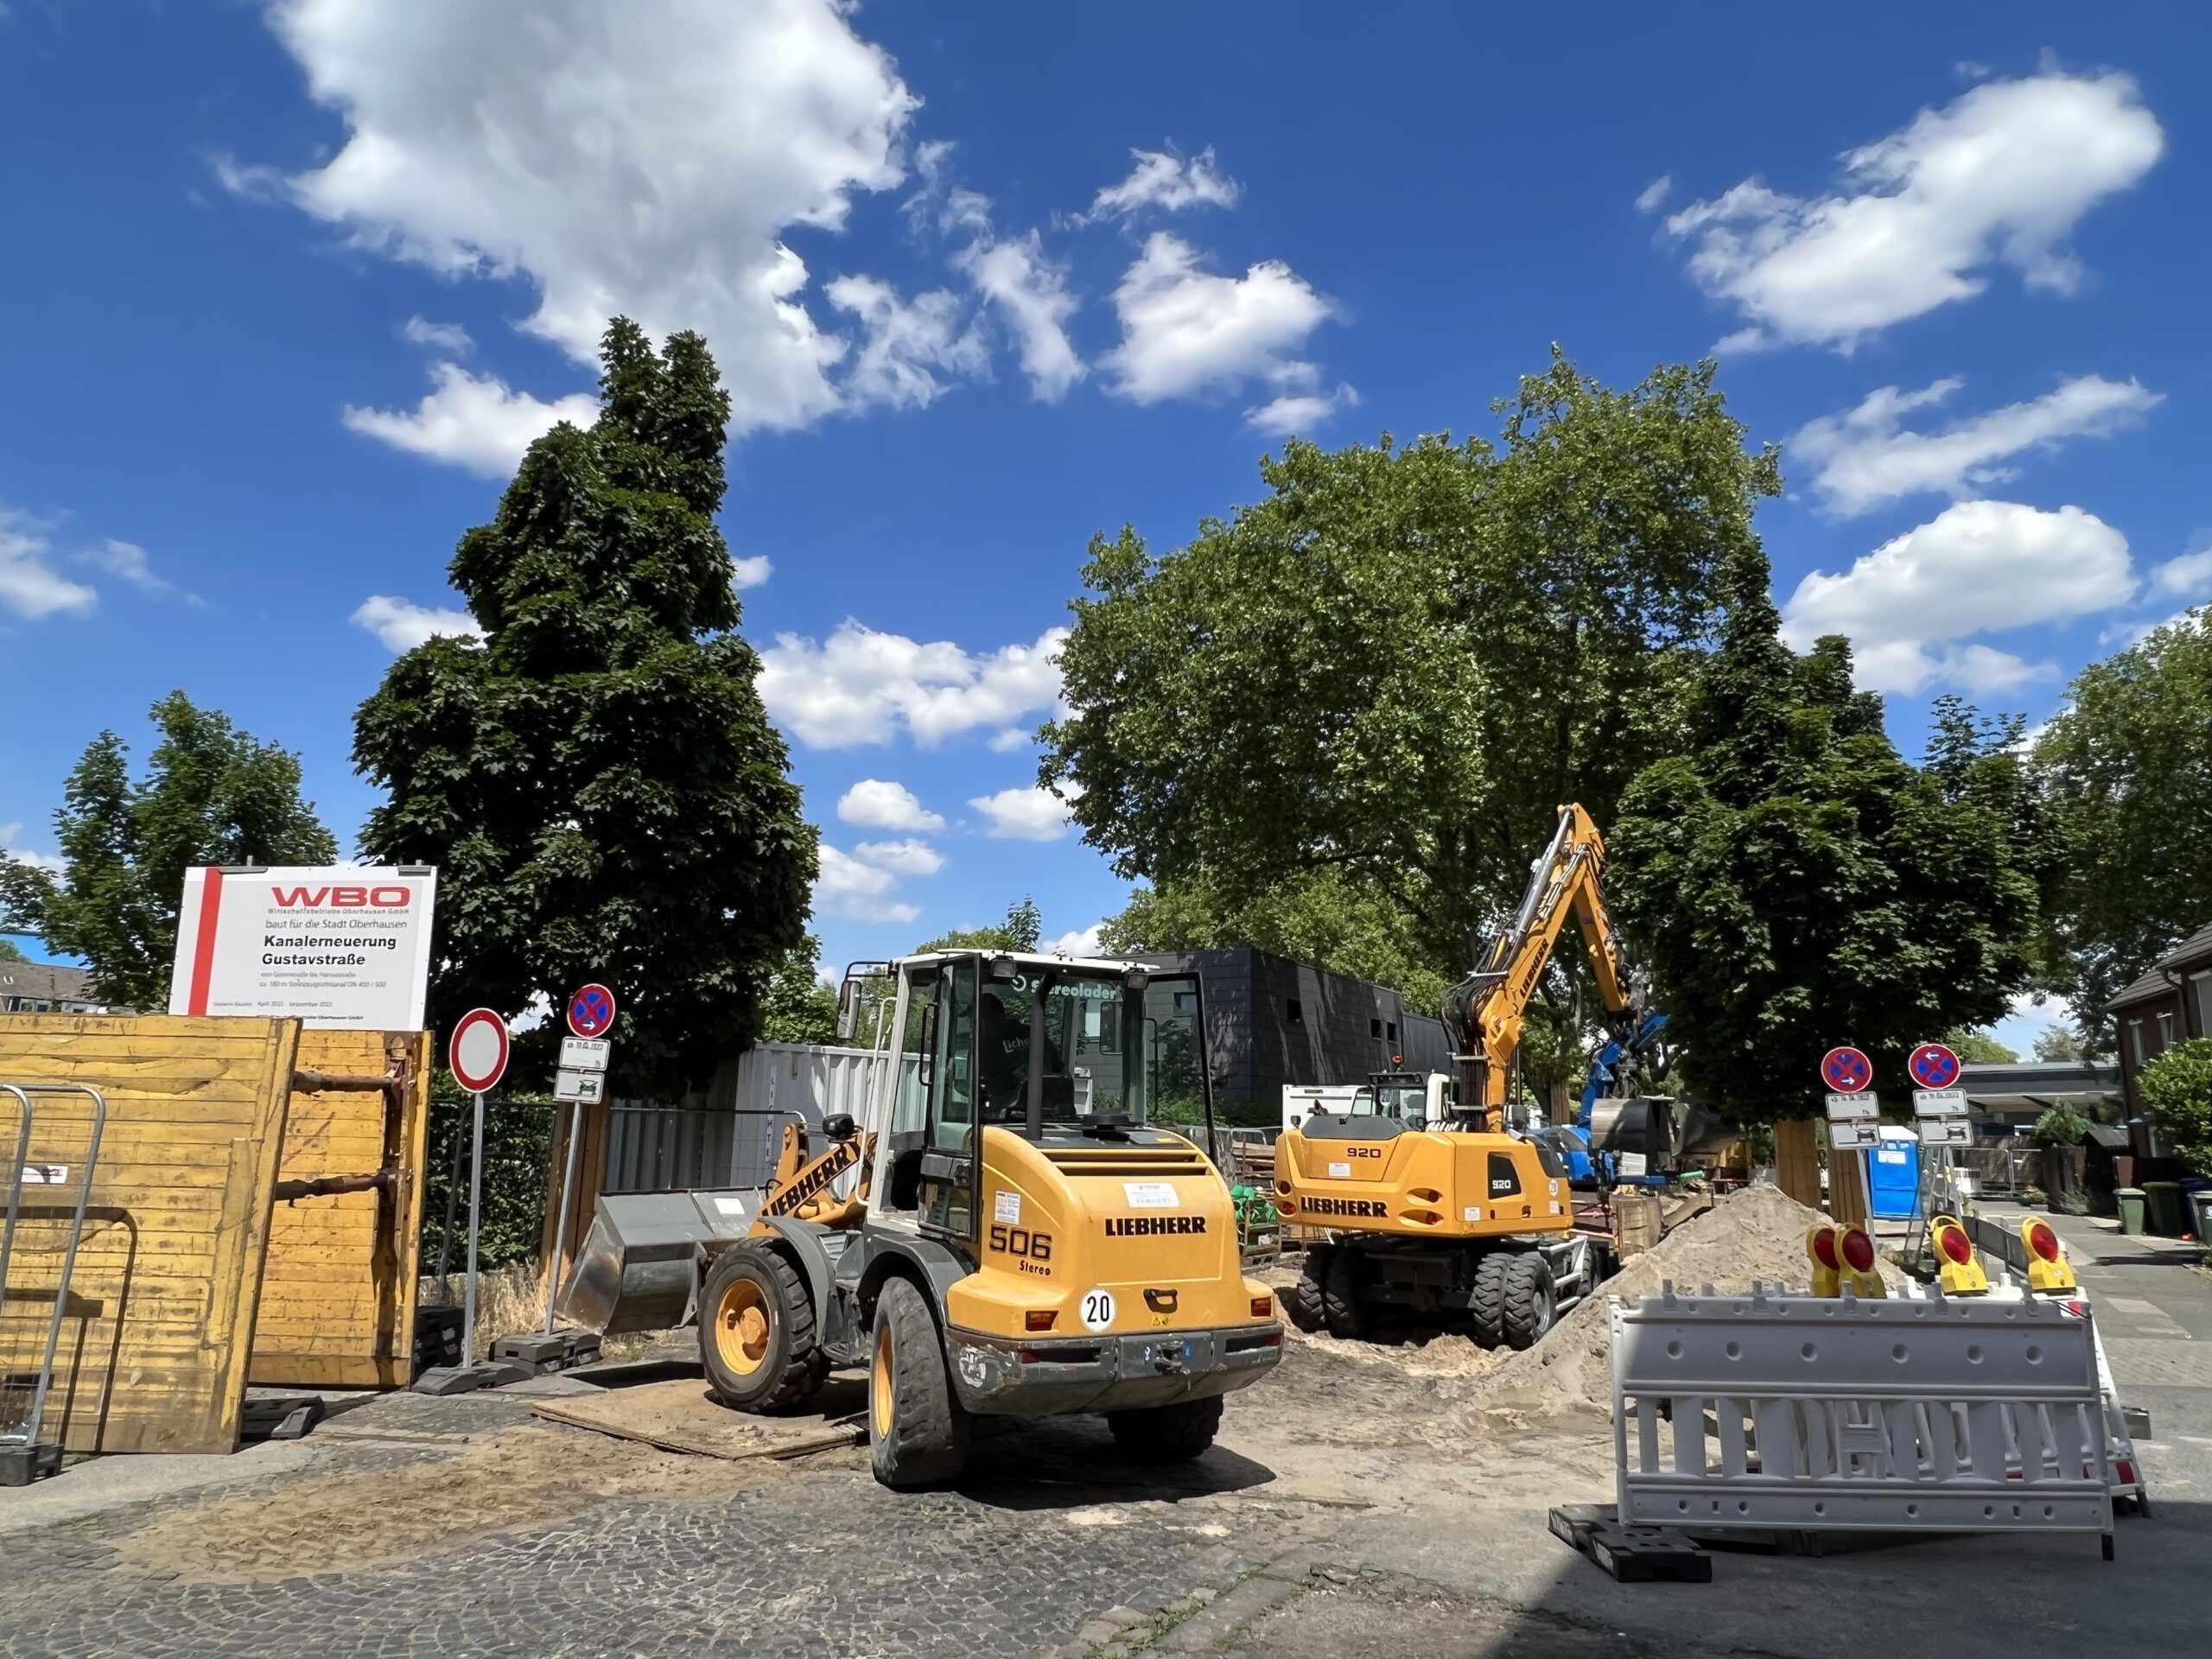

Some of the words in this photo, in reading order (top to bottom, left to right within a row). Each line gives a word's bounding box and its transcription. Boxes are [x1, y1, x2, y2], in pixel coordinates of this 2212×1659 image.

[270, 887, 410, 907] WBO
[265, 919, 287, 929] baut
[289, 919, 303, 929] für
[305, 919, 321, 929] die
[322, 919, 347, 929] Stadt
[349, 919, 408, 929] Oberhausen
[264, 935, 397, 950] Kanalerneuerung
[262, 953, 366, 965] Gustavstraße
[1031, 980, 1117, 1000] sreolader
[1347, 1147, 1381, 1158] 920
[1492, 1179, 1511, 1189] 920
[1300, 1196, 1389, 1217] LIEBHERR
[1105, 1216, 1206, 1236] LIEBHERR
[989, 1224, 1052, 1262] 506
[1020, 1260, 1051, 1276] Stereo
[1086, 1295, 1110, 1323] 20
